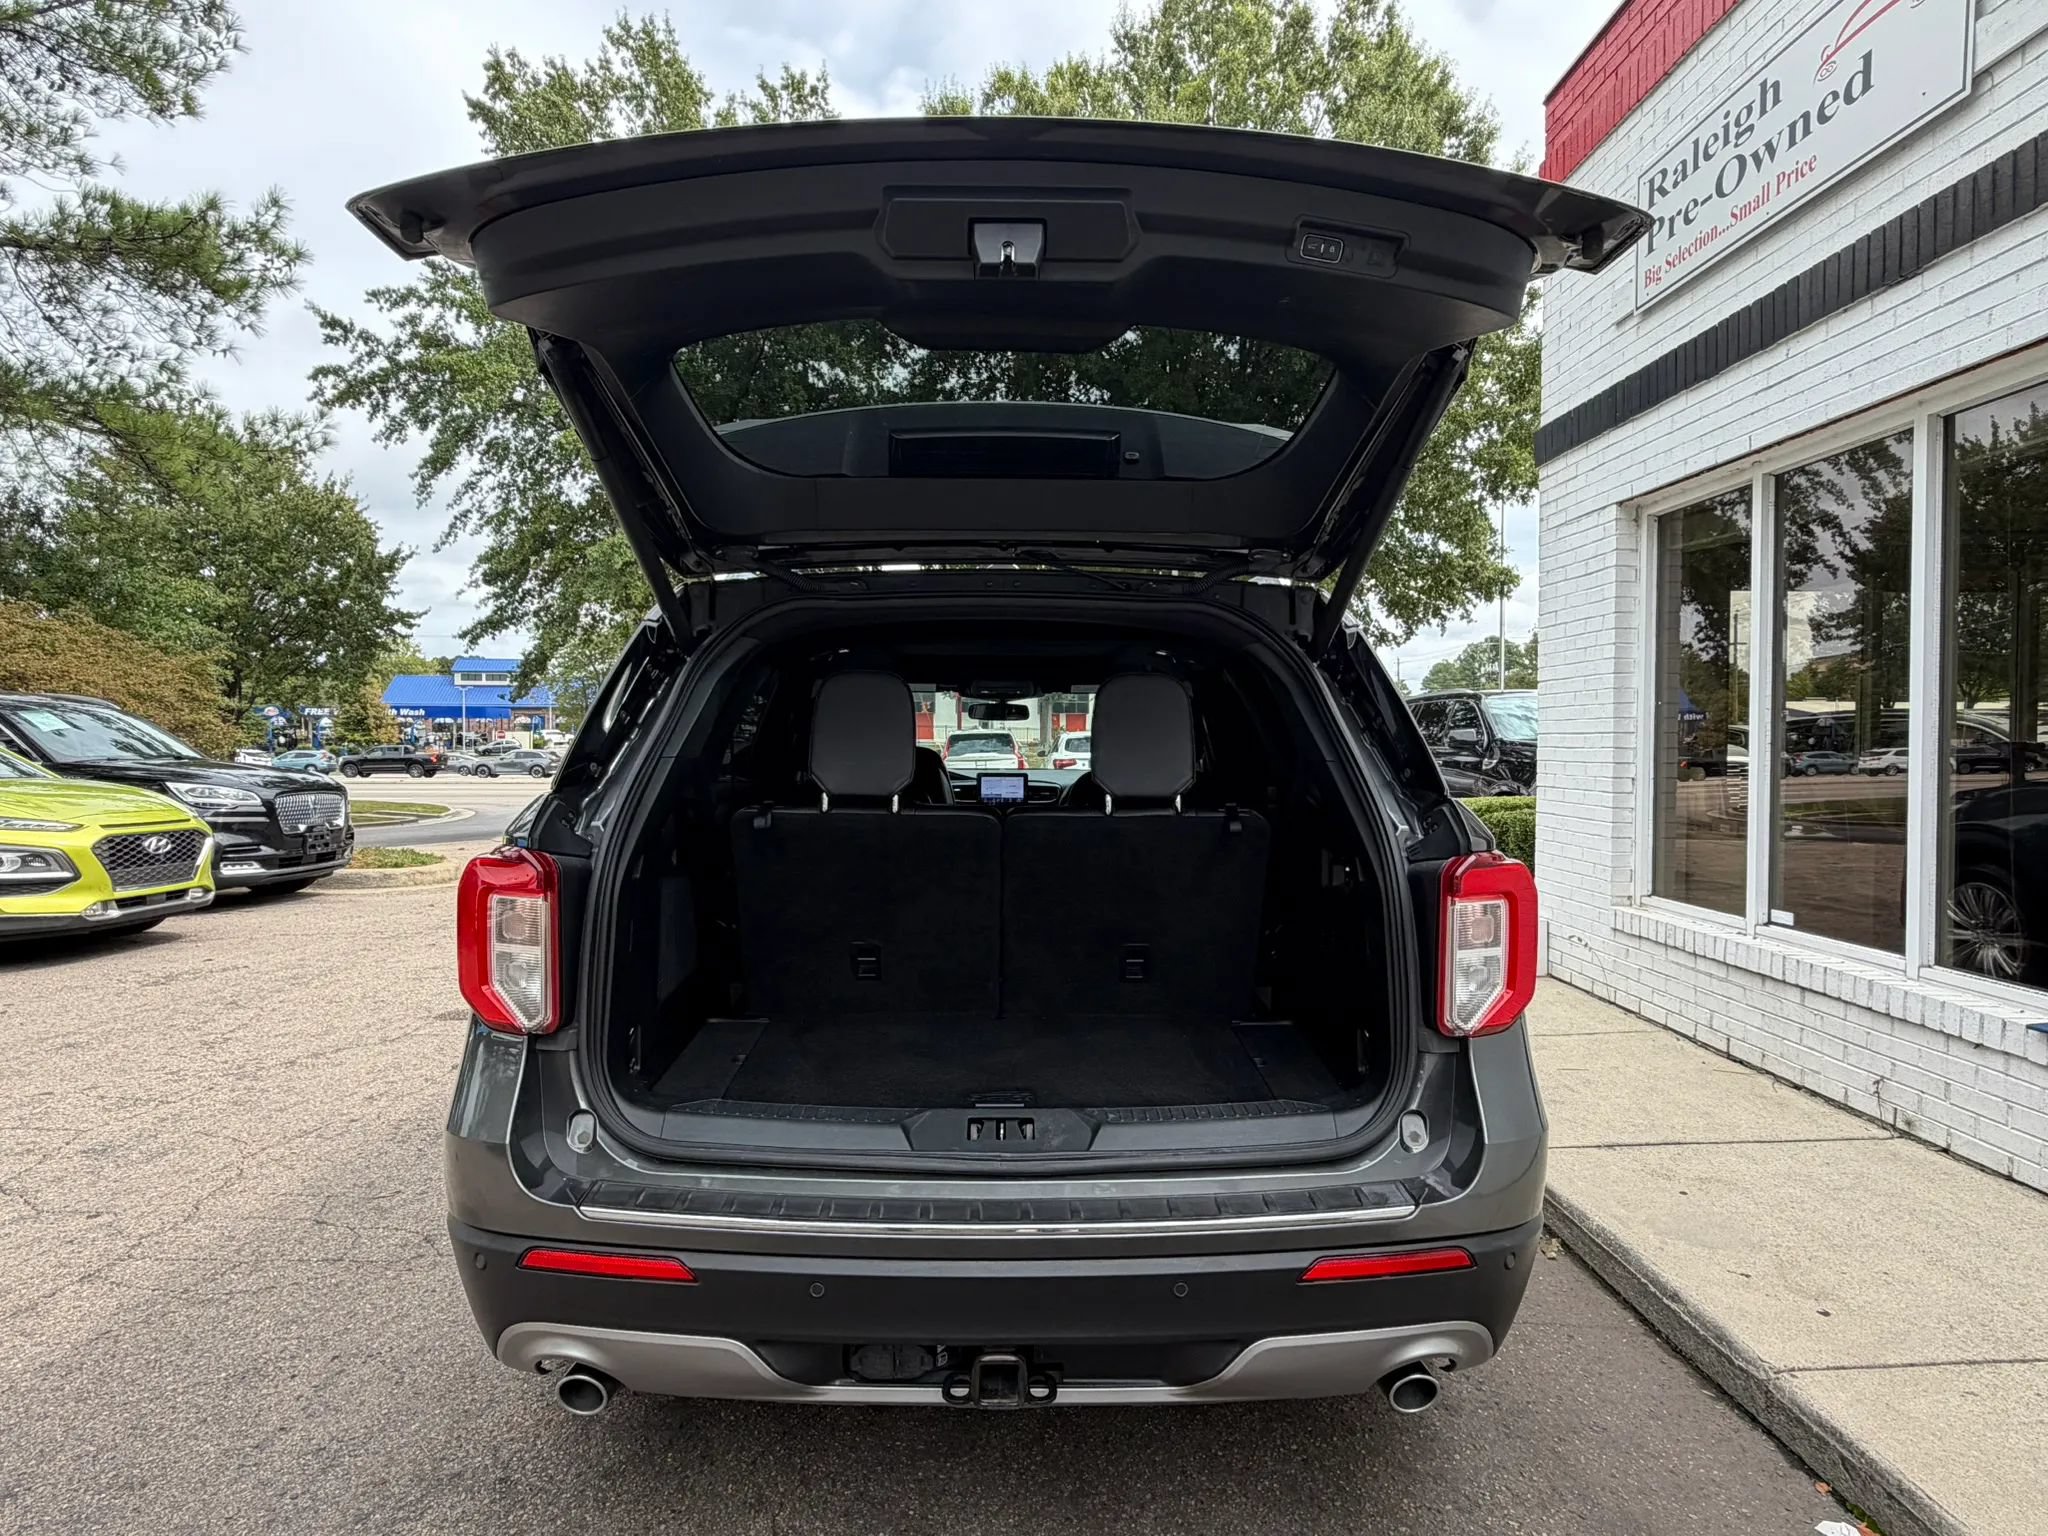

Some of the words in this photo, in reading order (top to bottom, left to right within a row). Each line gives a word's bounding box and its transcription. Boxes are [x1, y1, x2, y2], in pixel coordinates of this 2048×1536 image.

[1644, 49, 1875, 257] Pre-Owned
[1646, 77, 1783, 211] Raleigh
[1643, 264, 1662, 290] Big
[1775, 154, 1818, 197] Price
[304, 707, 330, 716] FREE
[399, 707, 426, 716] Wash
